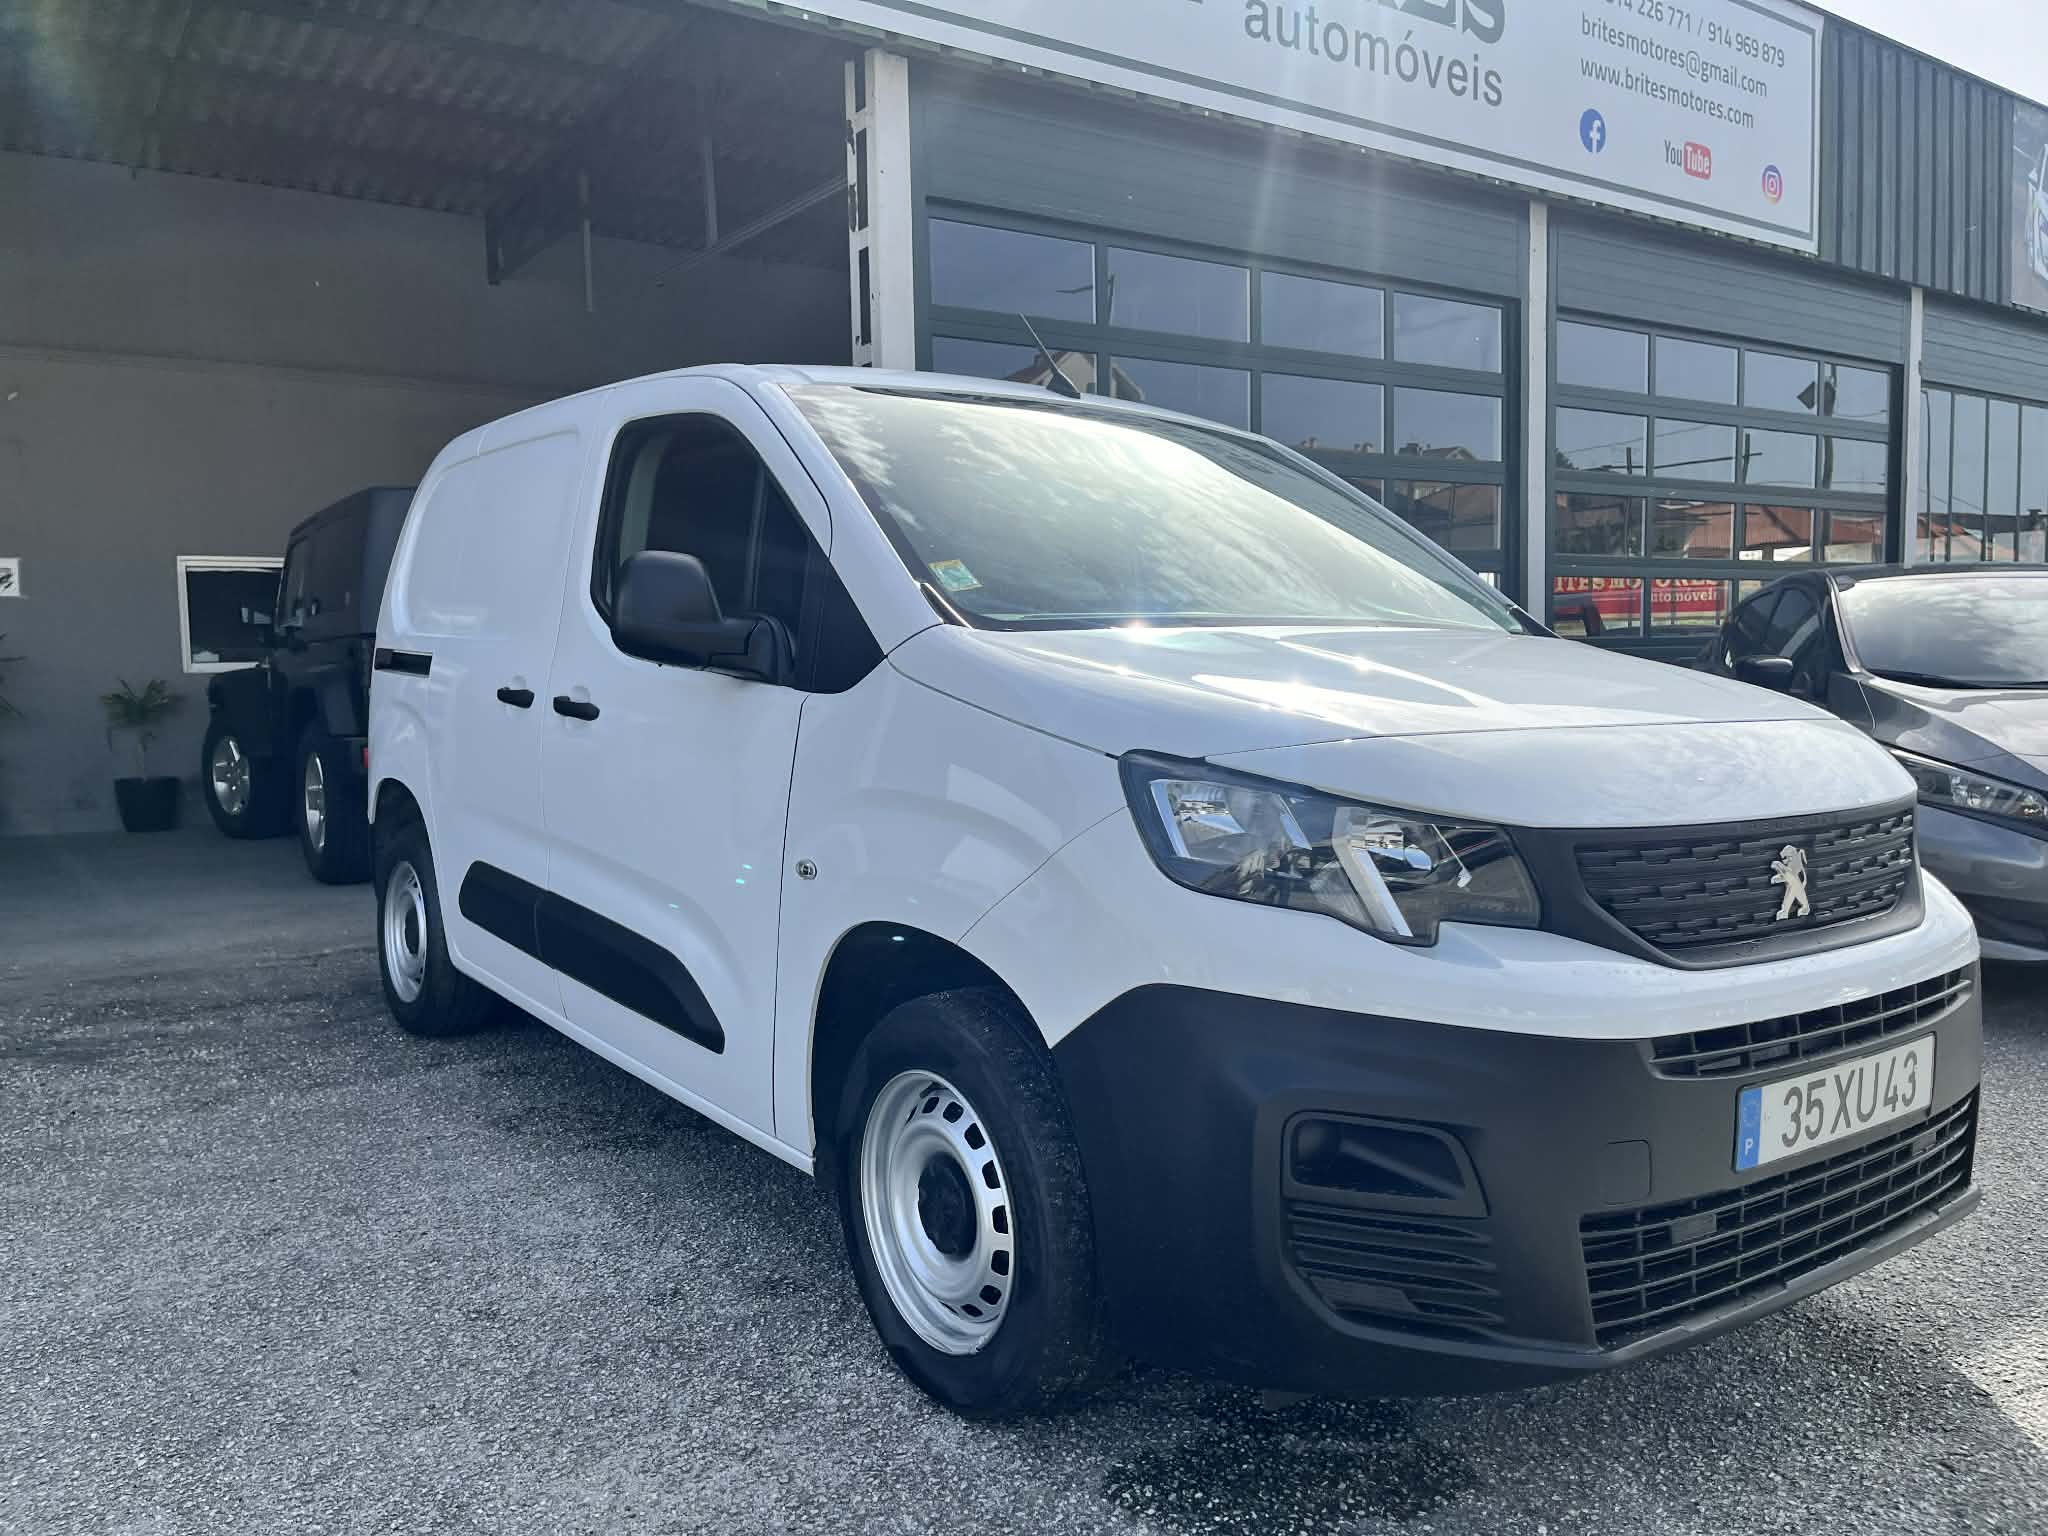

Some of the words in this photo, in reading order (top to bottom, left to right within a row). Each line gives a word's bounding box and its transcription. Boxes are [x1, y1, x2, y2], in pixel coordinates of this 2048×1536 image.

[1244, 0, 1502, 107] automóveis
[1581, 12, 1768, 98] britesmotores@gmail.com
[1667, 6, 1692, 33] 771
[1707, 22, 1733, 49] 914
[1735, 33, 1759, 59] 969
[1761, 43, 1786, 68] 879
[1580, 57, 1755, 129] www.britesmotores.com
[1744, 1137, 1754, 1157] P
